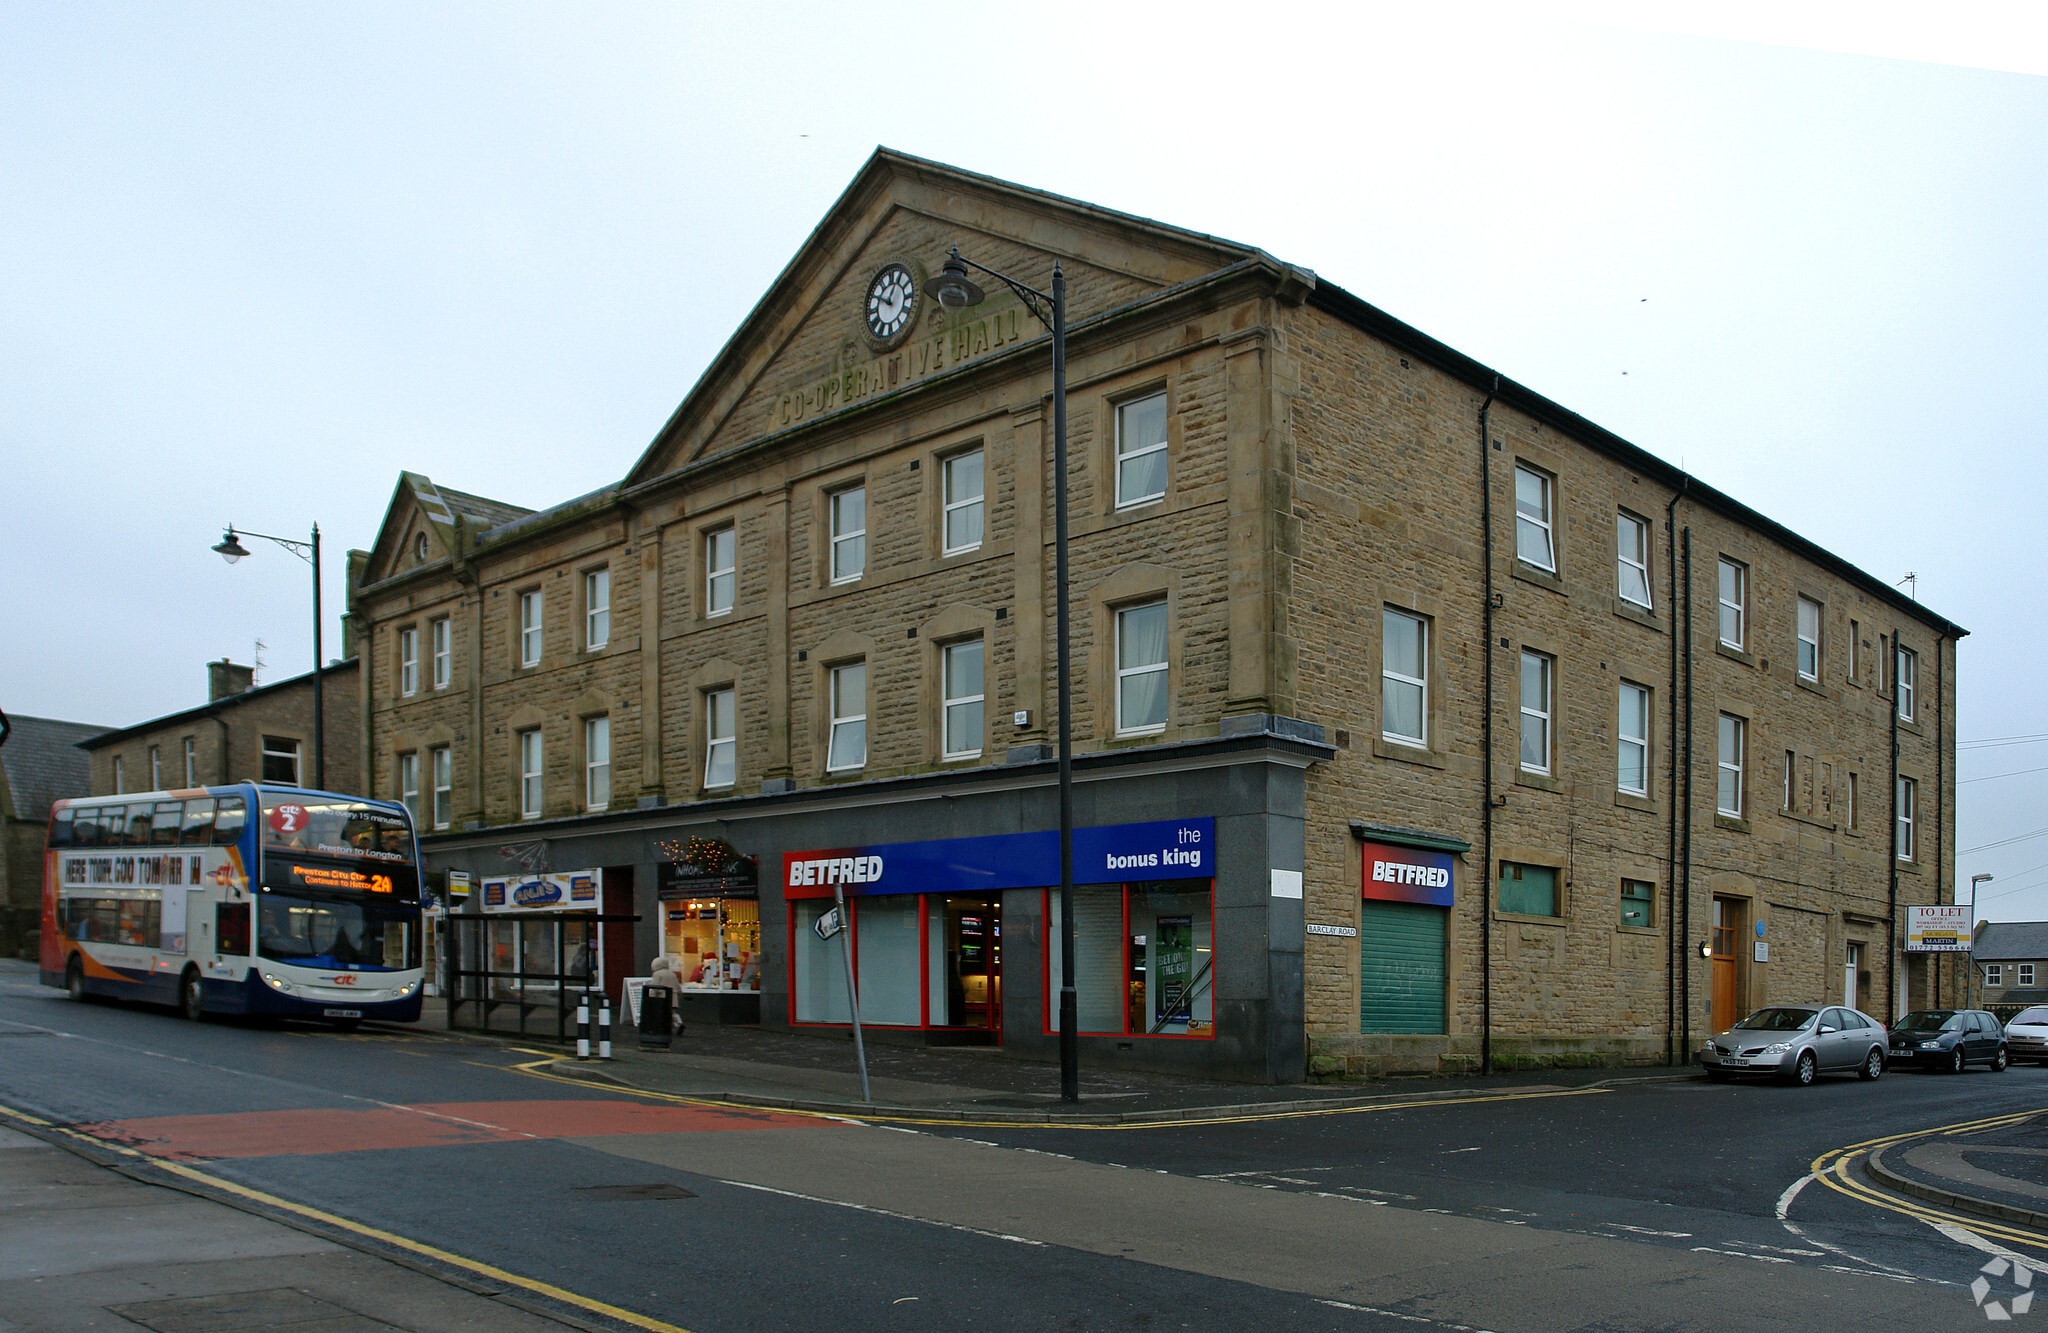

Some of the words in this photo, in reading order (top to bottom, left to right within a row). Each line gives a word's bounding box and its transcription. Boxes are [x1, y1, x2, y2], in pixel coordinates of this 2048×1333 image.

[780, 338, 943, 425] CO-OPERATIVE
[955, 309, 1019, 362] HALL
[281, 814, 296, 831] 2
[335, 811, 357, 820] every
[371, 815, 402, 825] minutes
[1178, 827, 1201, 844] the
[318, 843, 352, 854] Preston
[366, 849, 402, 860] Longton
[1106, 853, 1158, 870] bonus
[1163, 847, 1201, 868] king
[65, 859, 86, 884] HERE
[293, 865, 329, 877] Preston
[331, 870, 348, 880] City
[789, 855, 884, 887] BETFRED
[1372, 860, 1449, 888] BETFRED
[371, 874, 393, 893] 2A
[1918, 907, 1935, 917] TO
[1940, 907, 1964, 917] LET
[1308, 925, 1337, 935] BARCLAY
[1338, 927, 1356, 936] ROAD
[1158, 954, 1171, 966] BET
[1161, 964, 1175, 976] THE
